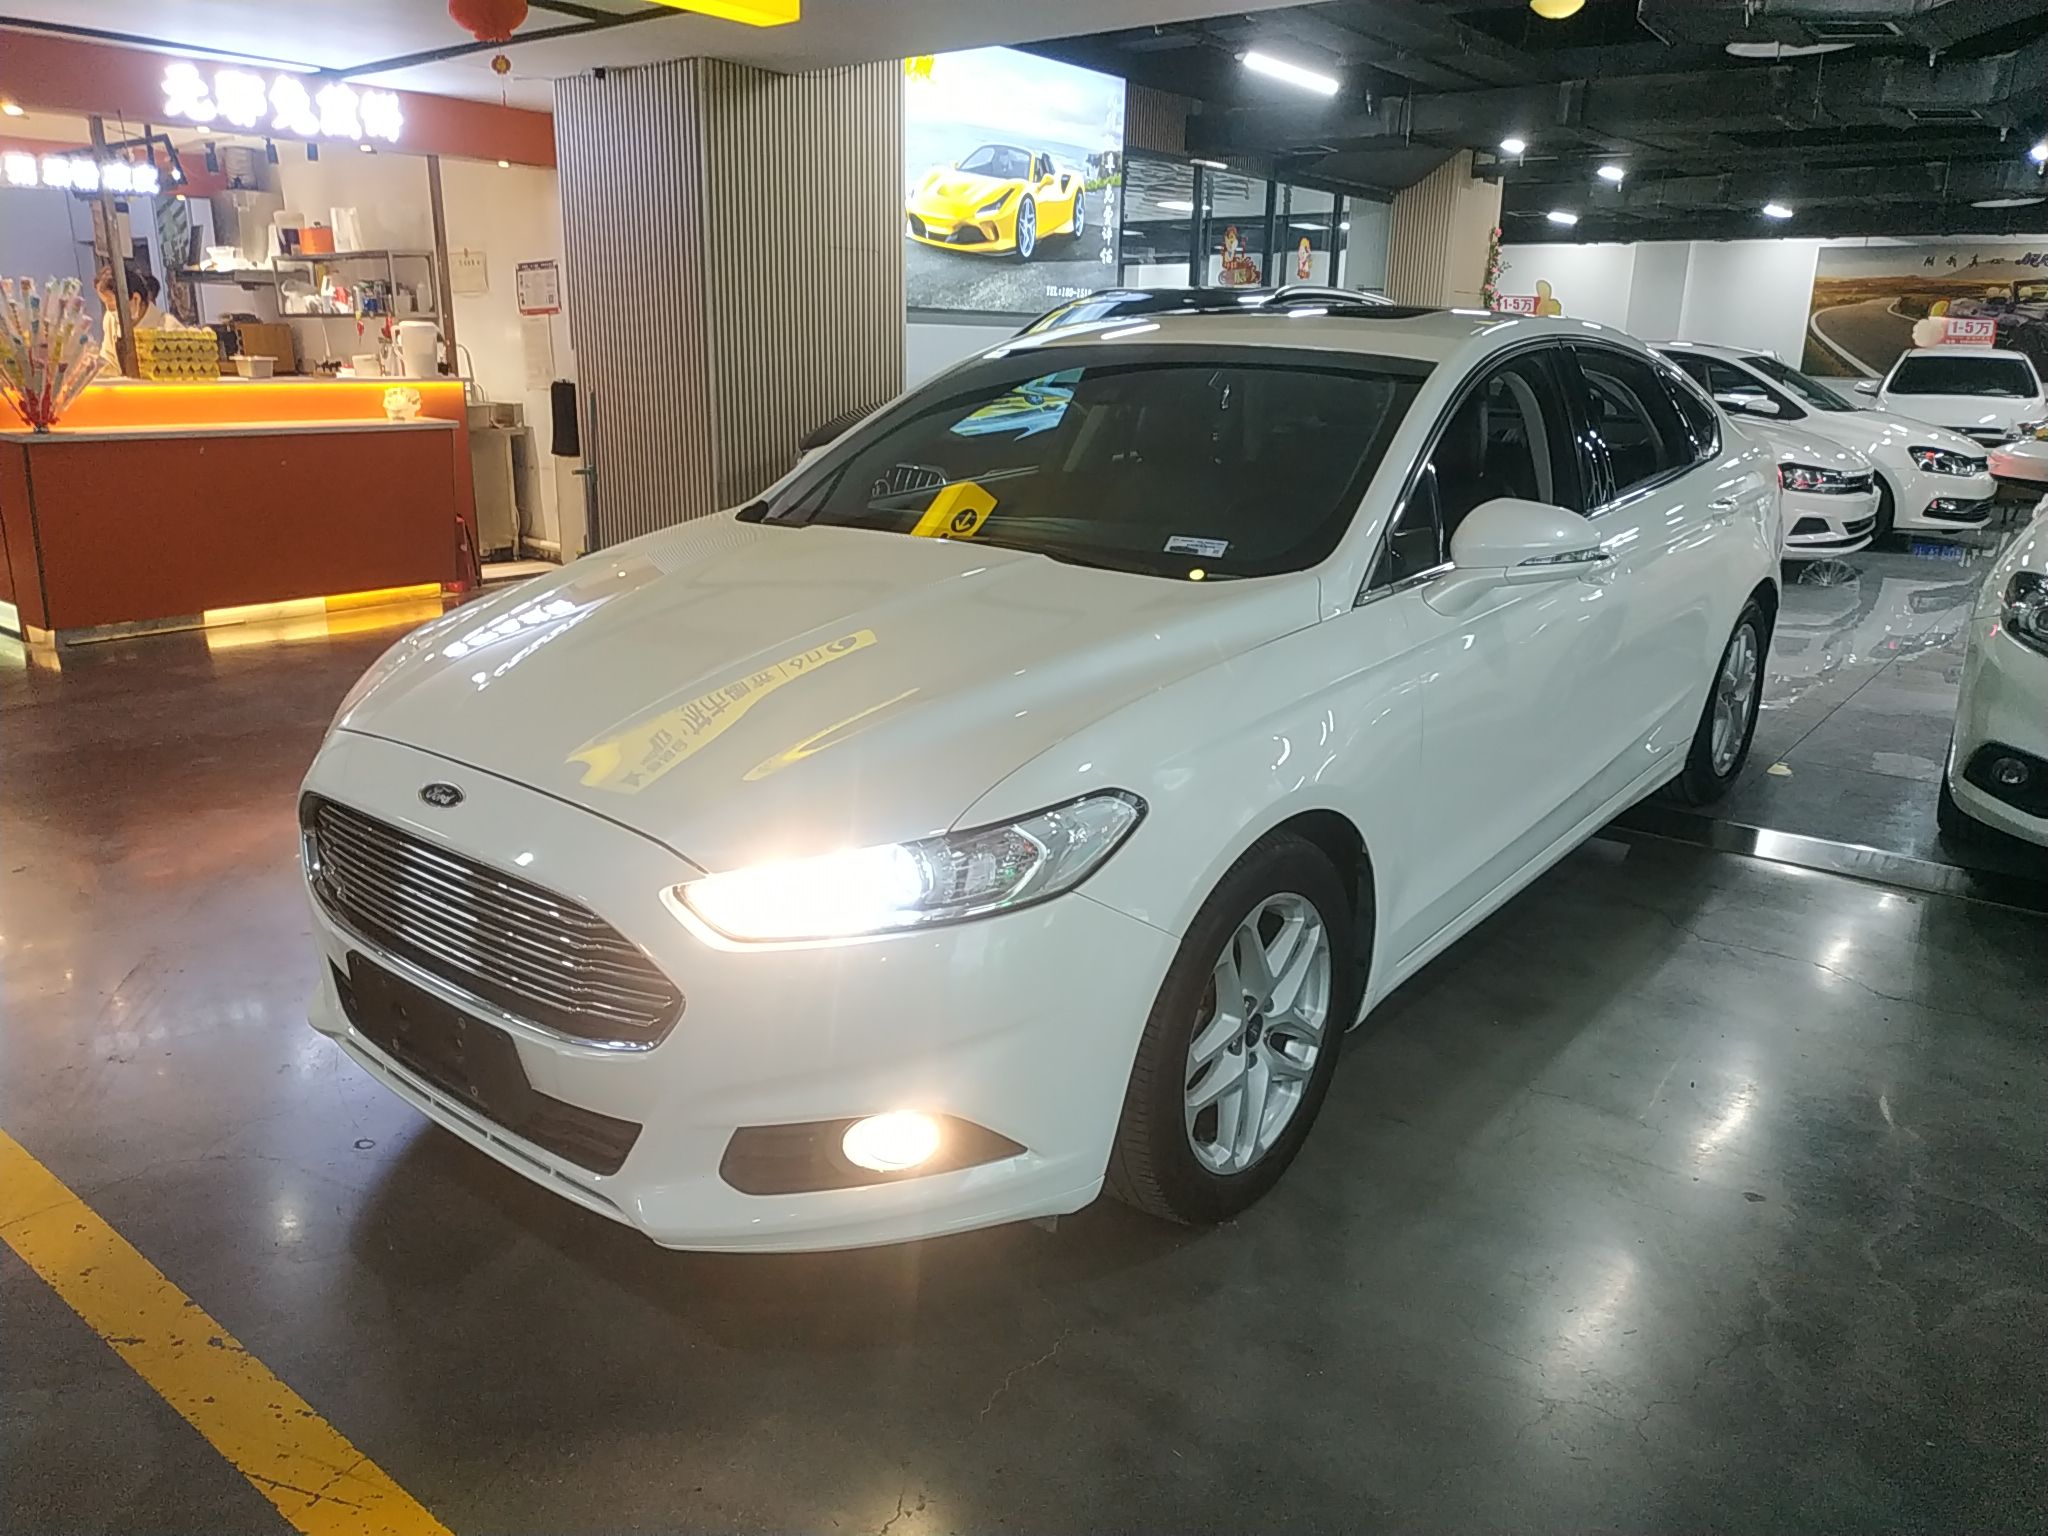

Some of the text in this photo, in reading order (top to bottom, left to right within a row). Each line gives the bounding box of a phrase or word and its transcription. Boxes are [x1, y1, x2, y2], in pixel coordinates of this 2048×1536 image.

[1503, 298, 1533, 312] 1-5万
[1952, 321, 1992, 335] 1-5万
[425, 786, 457, 805] Ford
